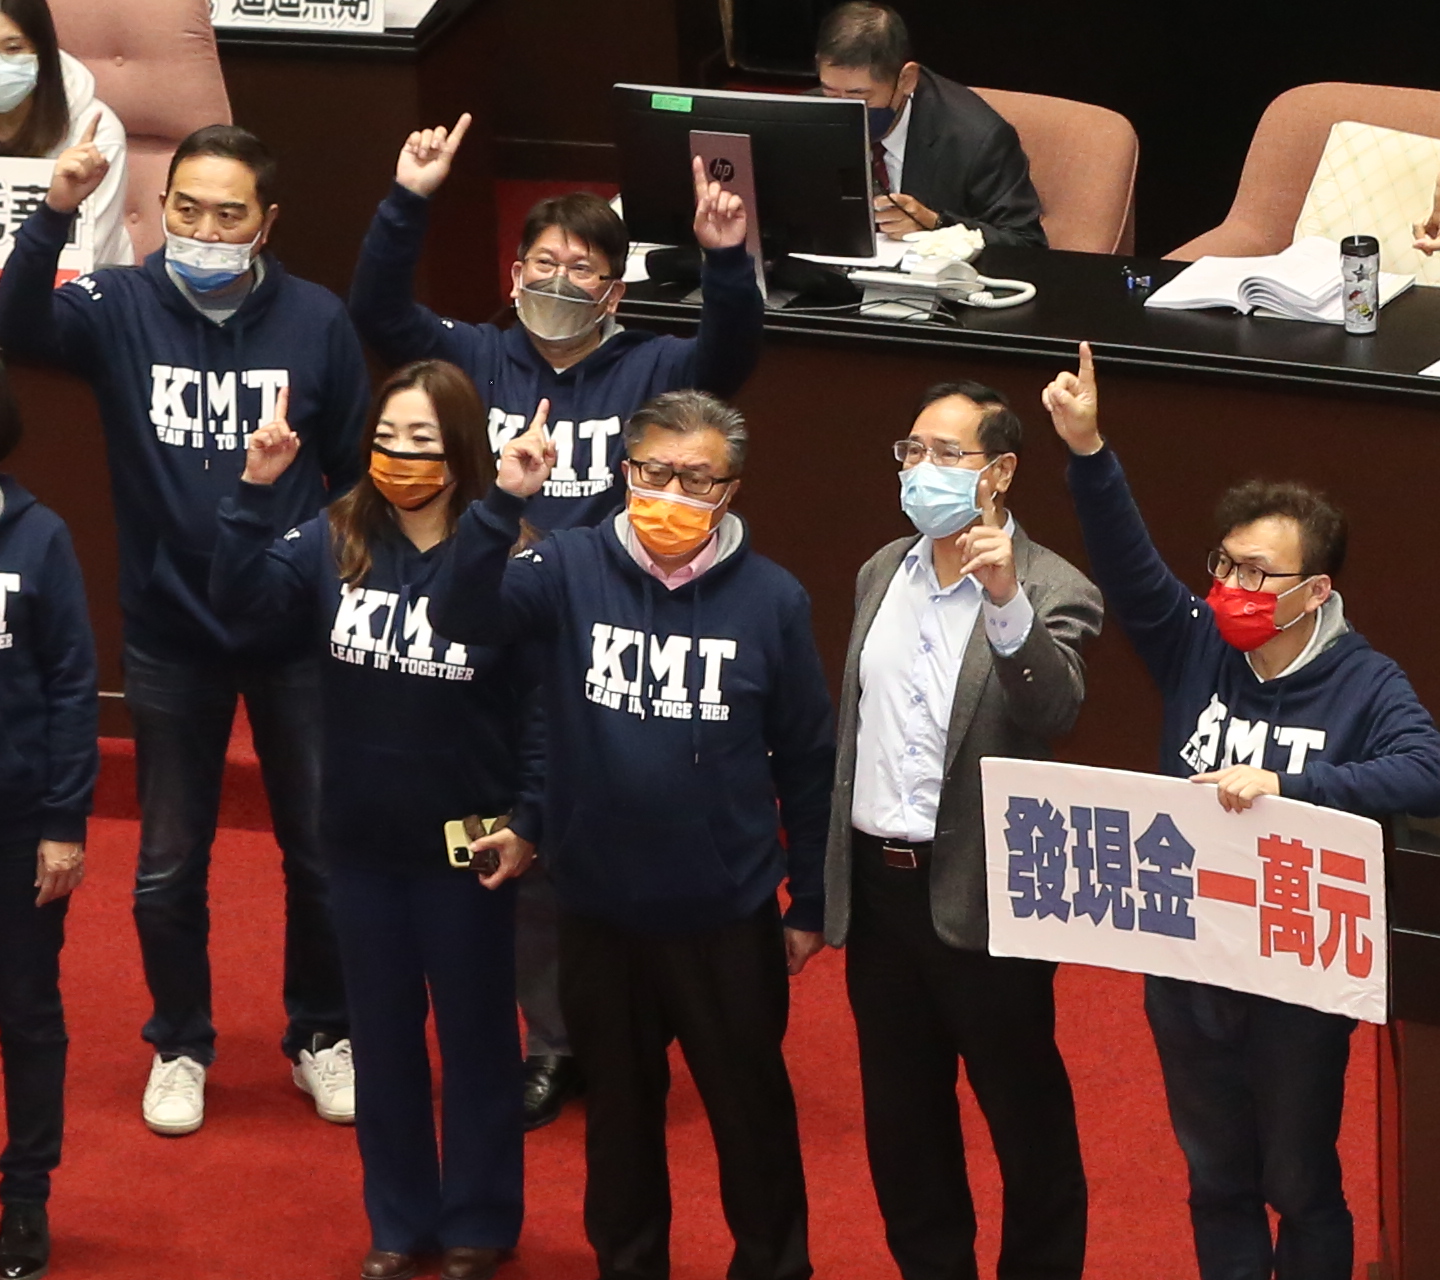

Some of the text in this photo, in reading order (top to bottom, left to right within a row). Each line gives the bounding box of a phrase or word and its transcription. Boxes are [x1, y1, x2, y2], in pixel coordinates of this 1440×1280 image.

[712, 158, 733, 181] hp
[149, 364, 290, 434] KMT
[330, 642, 475, 682] LEAN IN TOGETHER
[585, 622, 738, 704] KMT
[585, 682, 622, 711] LEAN
[1004, 794, 1372, 980] 發現金一萬元
